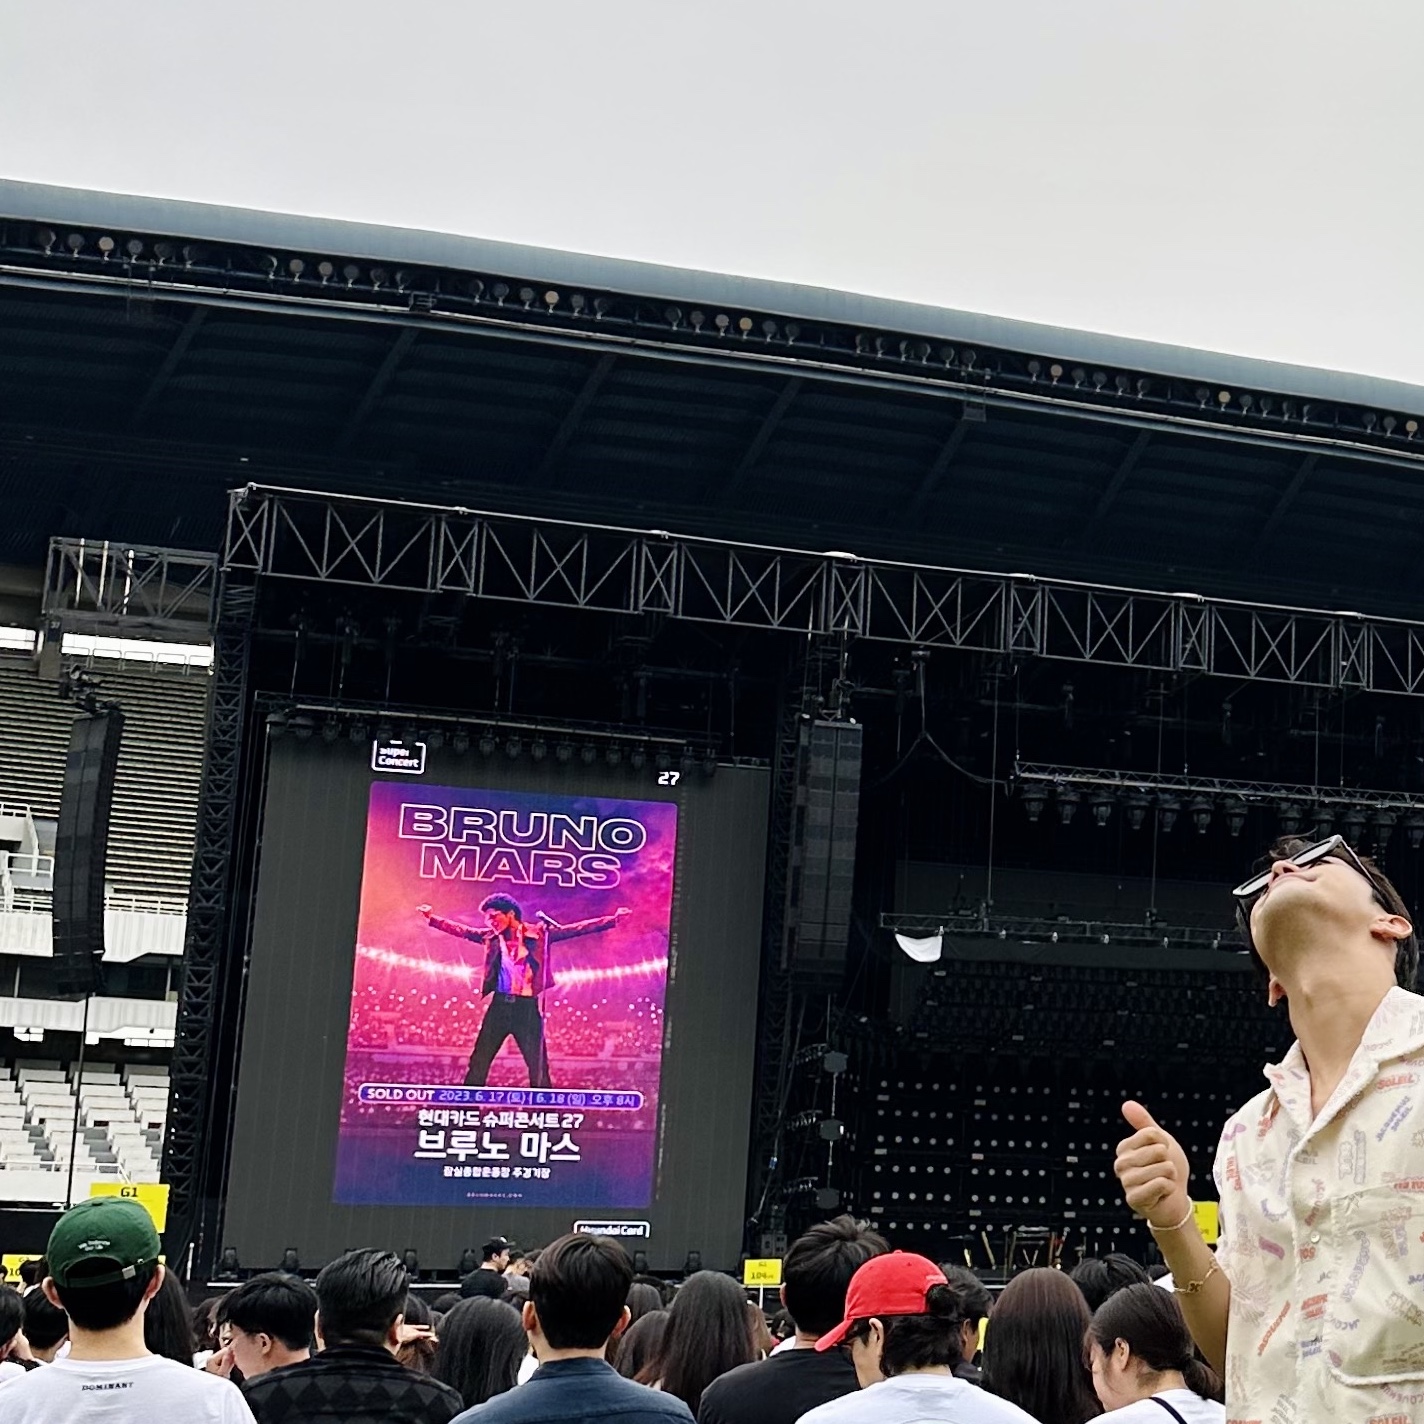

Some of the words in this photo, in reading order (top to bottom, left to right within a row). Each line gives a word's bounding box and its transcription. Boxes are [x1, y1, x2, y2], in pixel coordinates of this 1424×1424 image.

[378, 755, 420, 768] Concert
[657, 771, 680, 786] 27
[398, 803, 647, 853] BRUNO
[419, 843, 622, 890] MARS
[367, 1087, 404, 1101] SOLD
[405, 1088, 436, 1101] OUT
[418, 1108, 480, 1127] 현대카드
[482, 1110, 560, 1129] 슈퍼콘서트
[561, 1113, 584, 1129] 27
[414, 1129, 510, 1162] 브루노
[520, 1131, 581, 1163] 마스
[120, 1186, 139, 1198] G1
